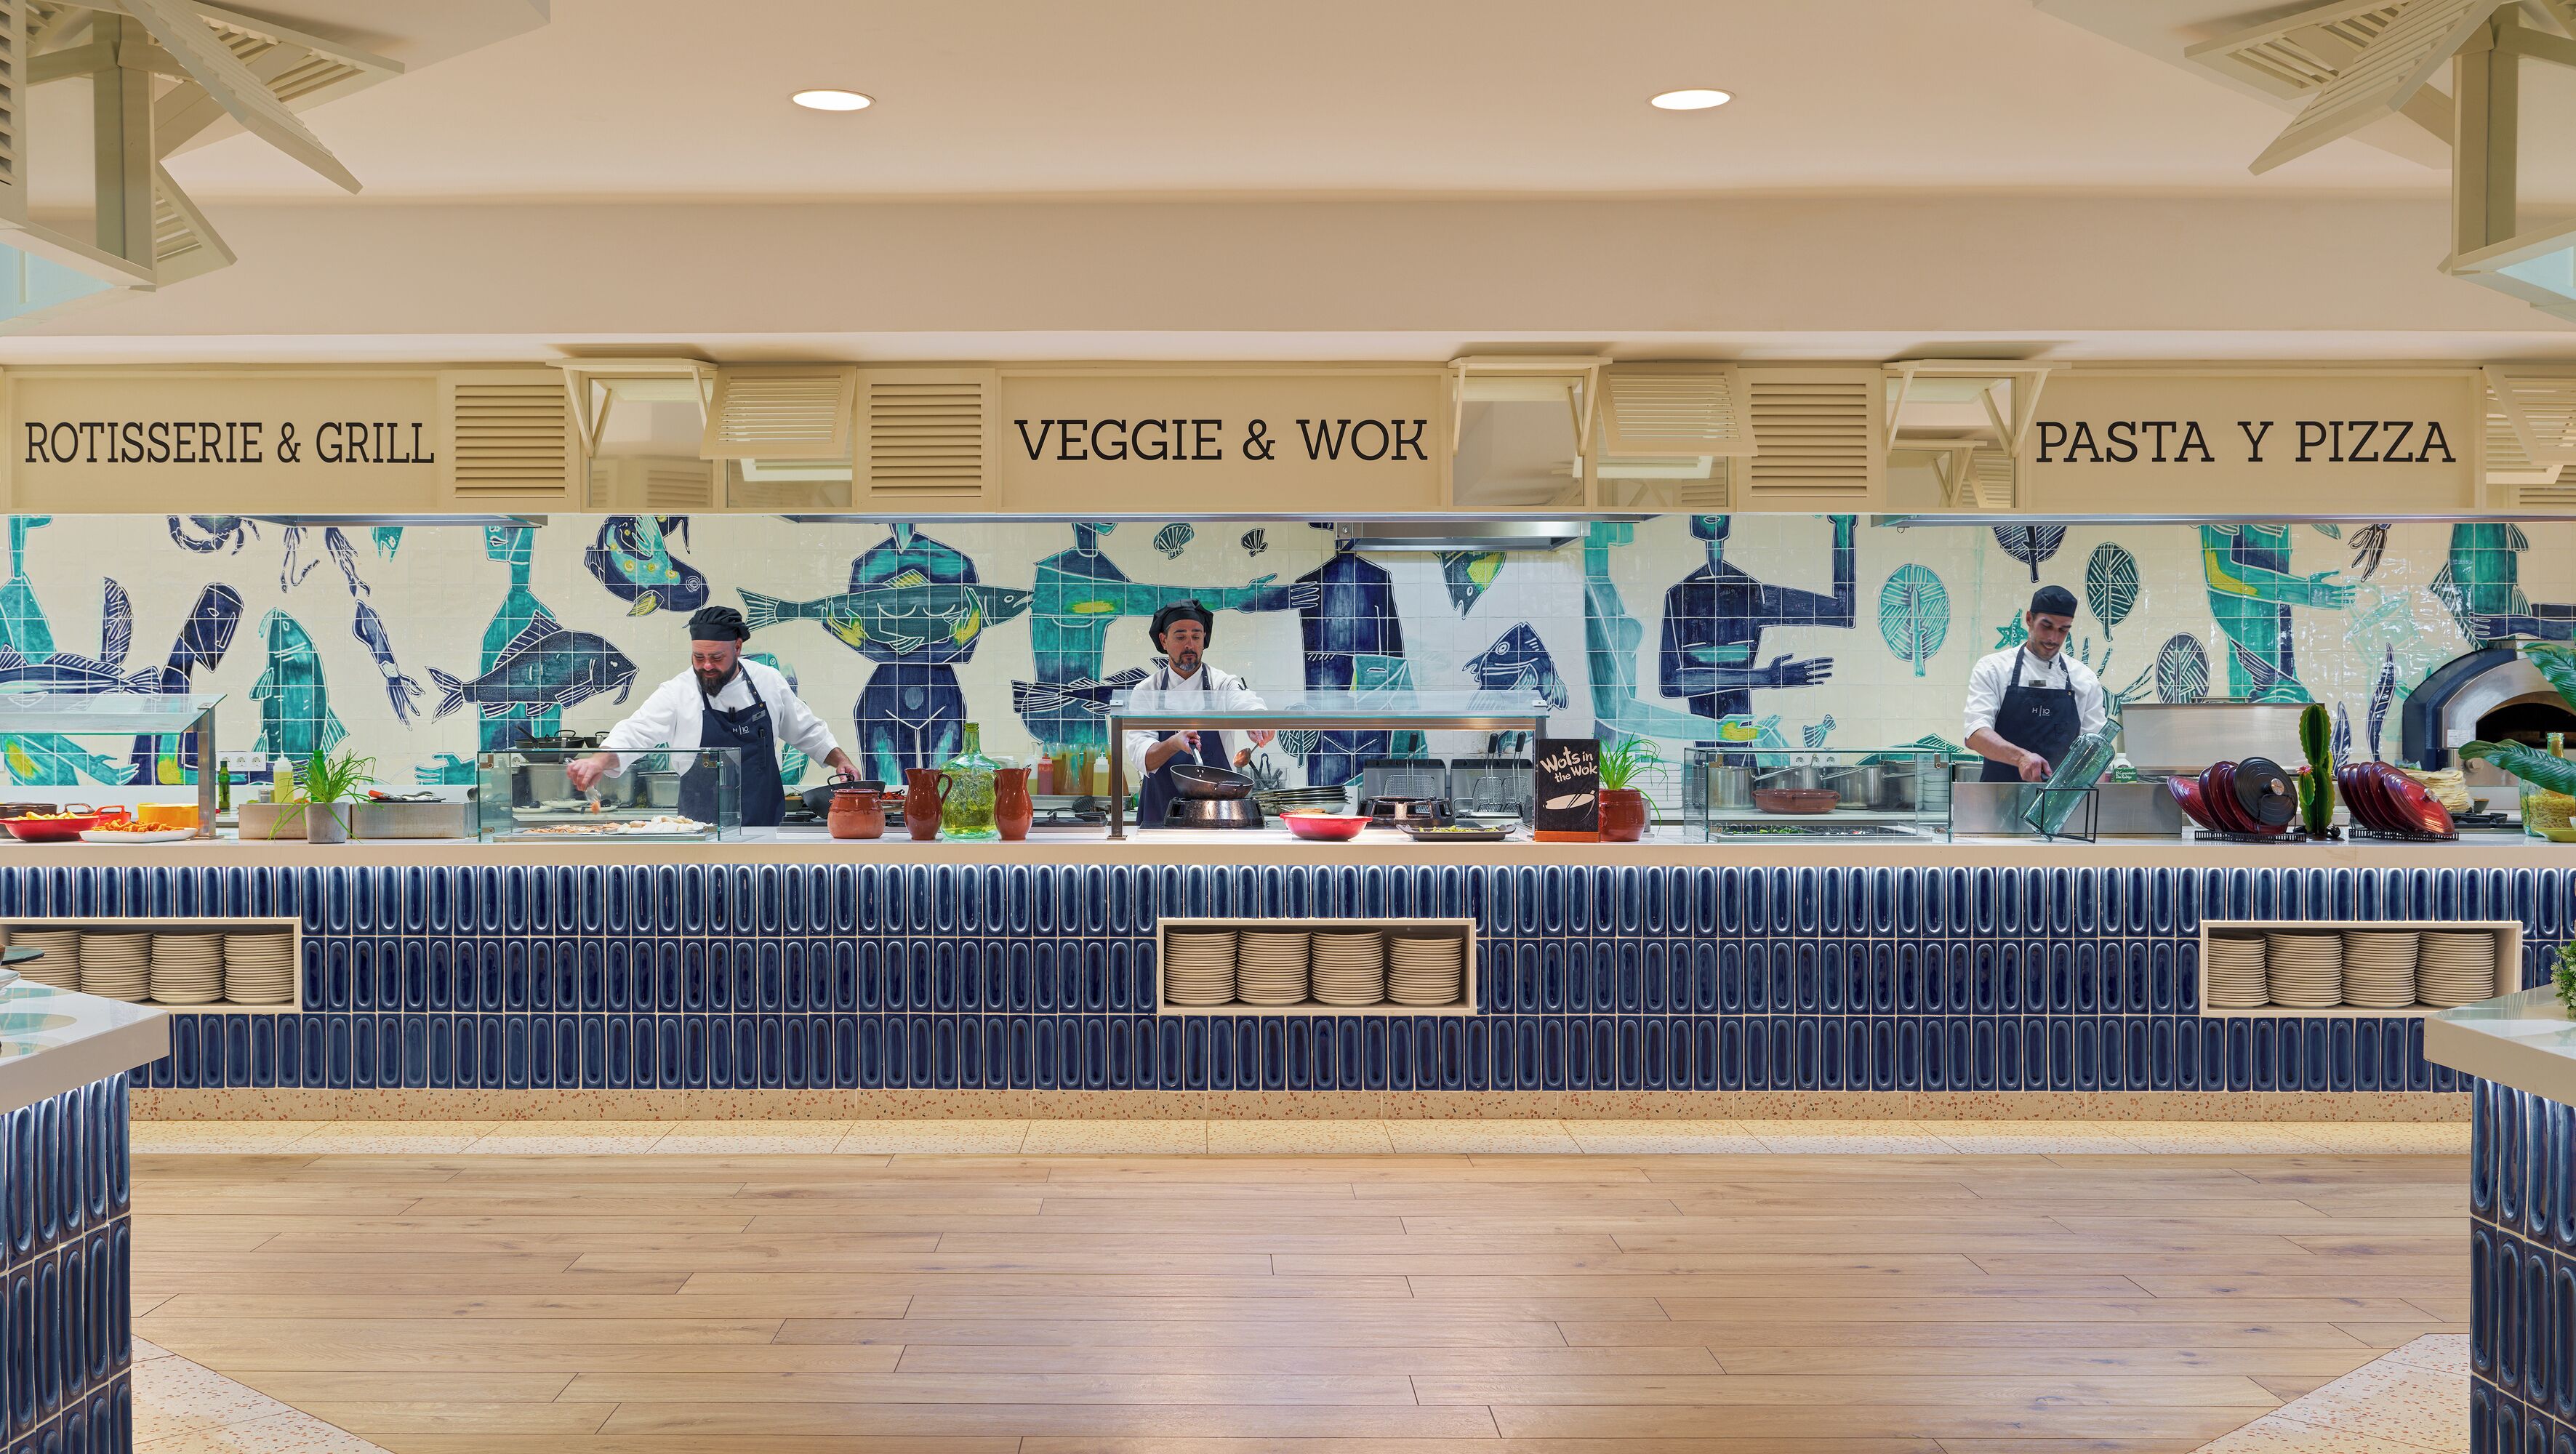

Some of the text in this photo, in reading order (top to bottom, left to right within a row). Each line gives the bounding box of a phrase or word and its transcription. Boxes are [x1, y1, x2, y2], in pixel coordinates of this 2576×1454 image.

[25, 422, 435, 464] ROTISSERIE & GRILL
[1014, 419, 1428, 461] VEGGIE & WOK
[2036, 420, 2457, 463] PASTA Y PIZZA
[1540, 746, 1593, 773] Wots in
[1554, 762, 1598, 783] the Wok
